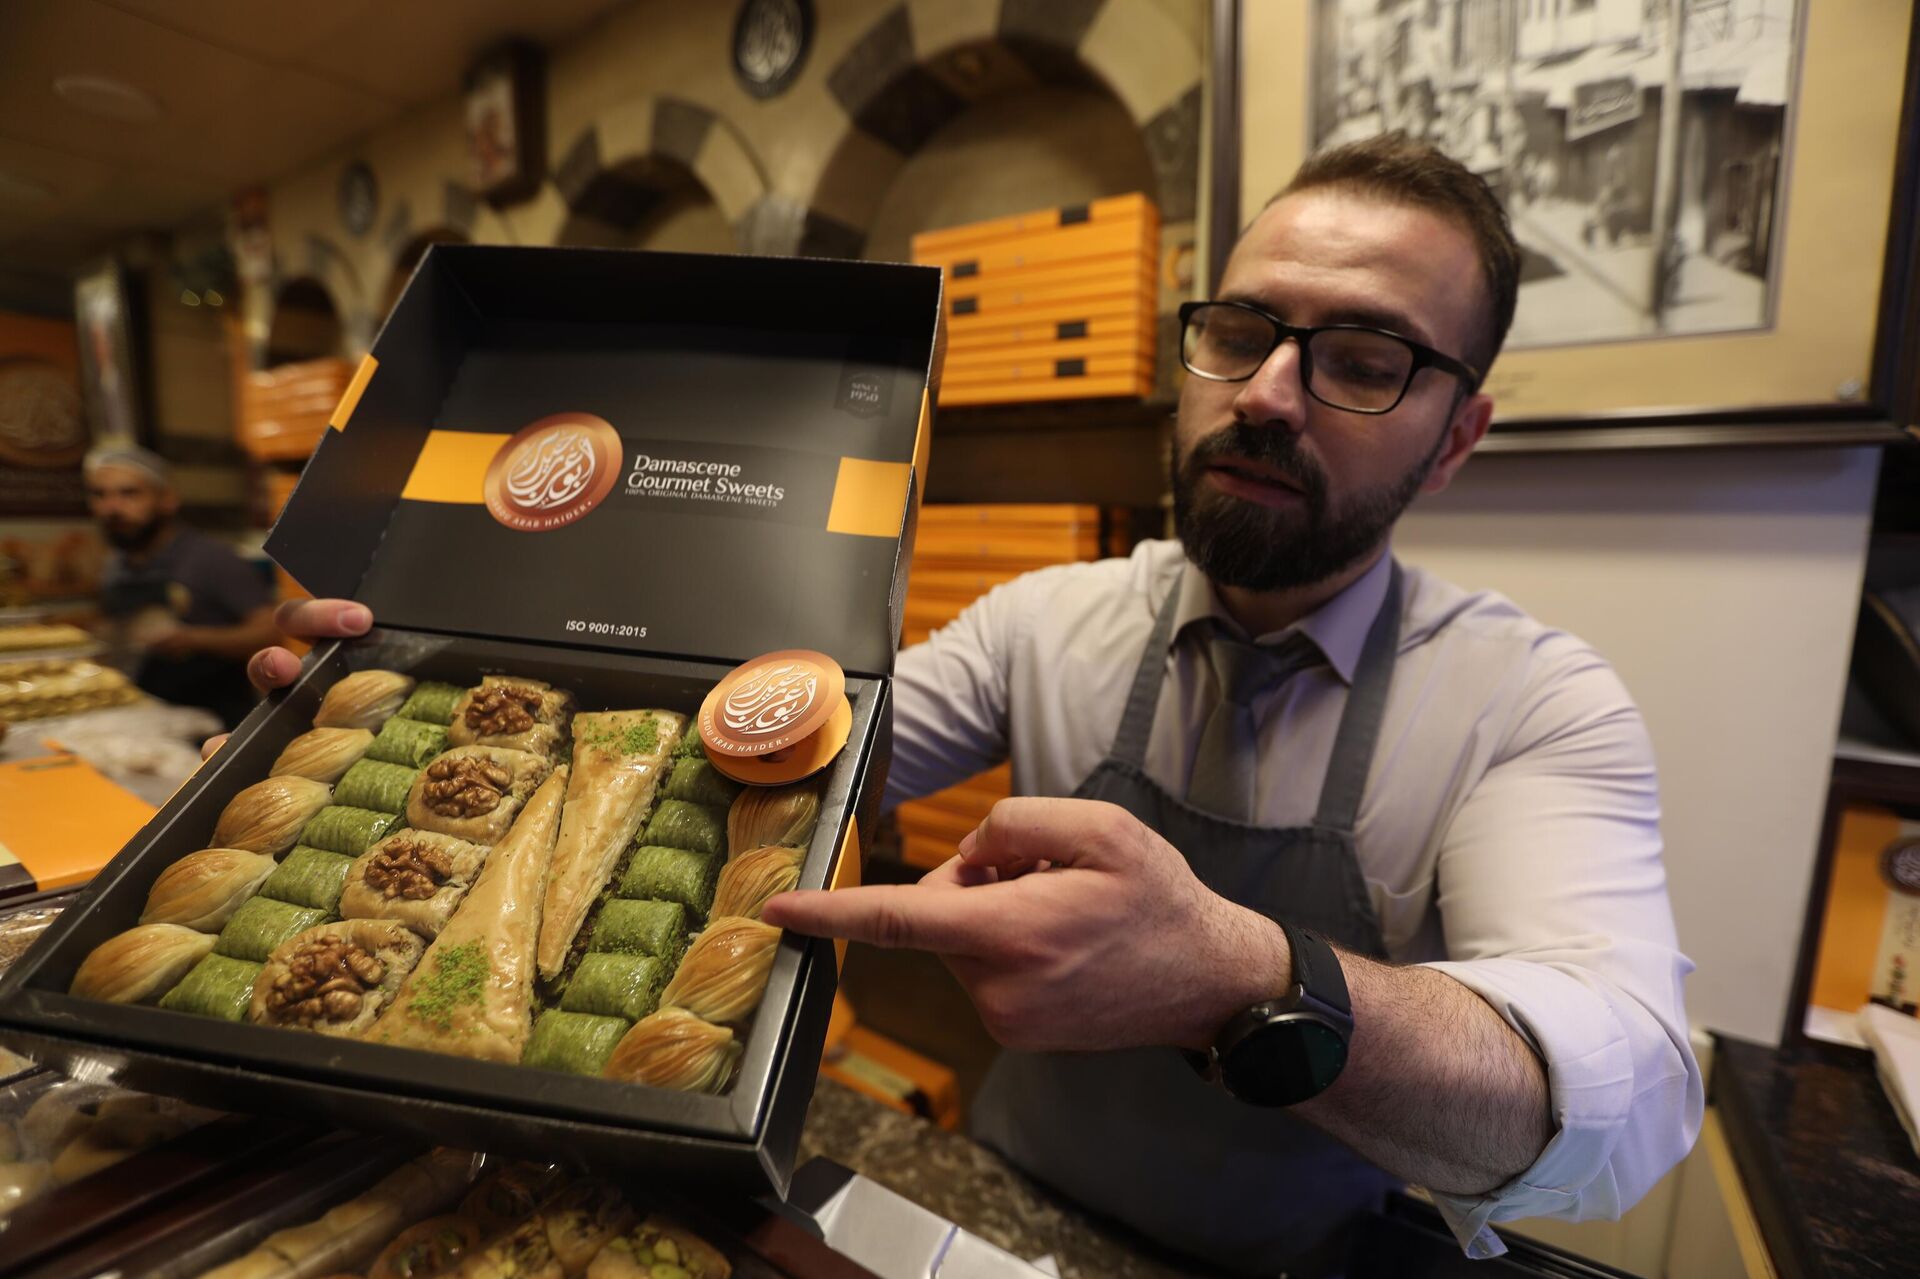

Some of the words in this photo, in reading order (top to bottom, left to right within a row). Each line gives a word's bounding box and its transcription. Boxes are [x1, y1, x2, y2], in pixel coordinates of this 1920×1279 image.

[850, 390, 879, 402] 1950
[633, 454, 741, 477] Damascene
[627, 471, 712, 493] Gourmet
[714, 477, 785, 501] Sweets
[625, 488, 646, 497] 100%
[647, 489, 688, 499] ORIGINAL
[690, 492, 743, 504] DAMASCENE
[743, 498, 778, 508] SWEETS
[512, 518, 540, 528] ARAB
[544, 505, 588, 527] HAIDER
[565, 619, 586, 632] ISO
[588, 622, 648, 638] 9001:2015
[703, 714, 714, 736] ABOU
[712, 736, 735, 751] ARAB
[737, 739, 783, 753] HAIDER
